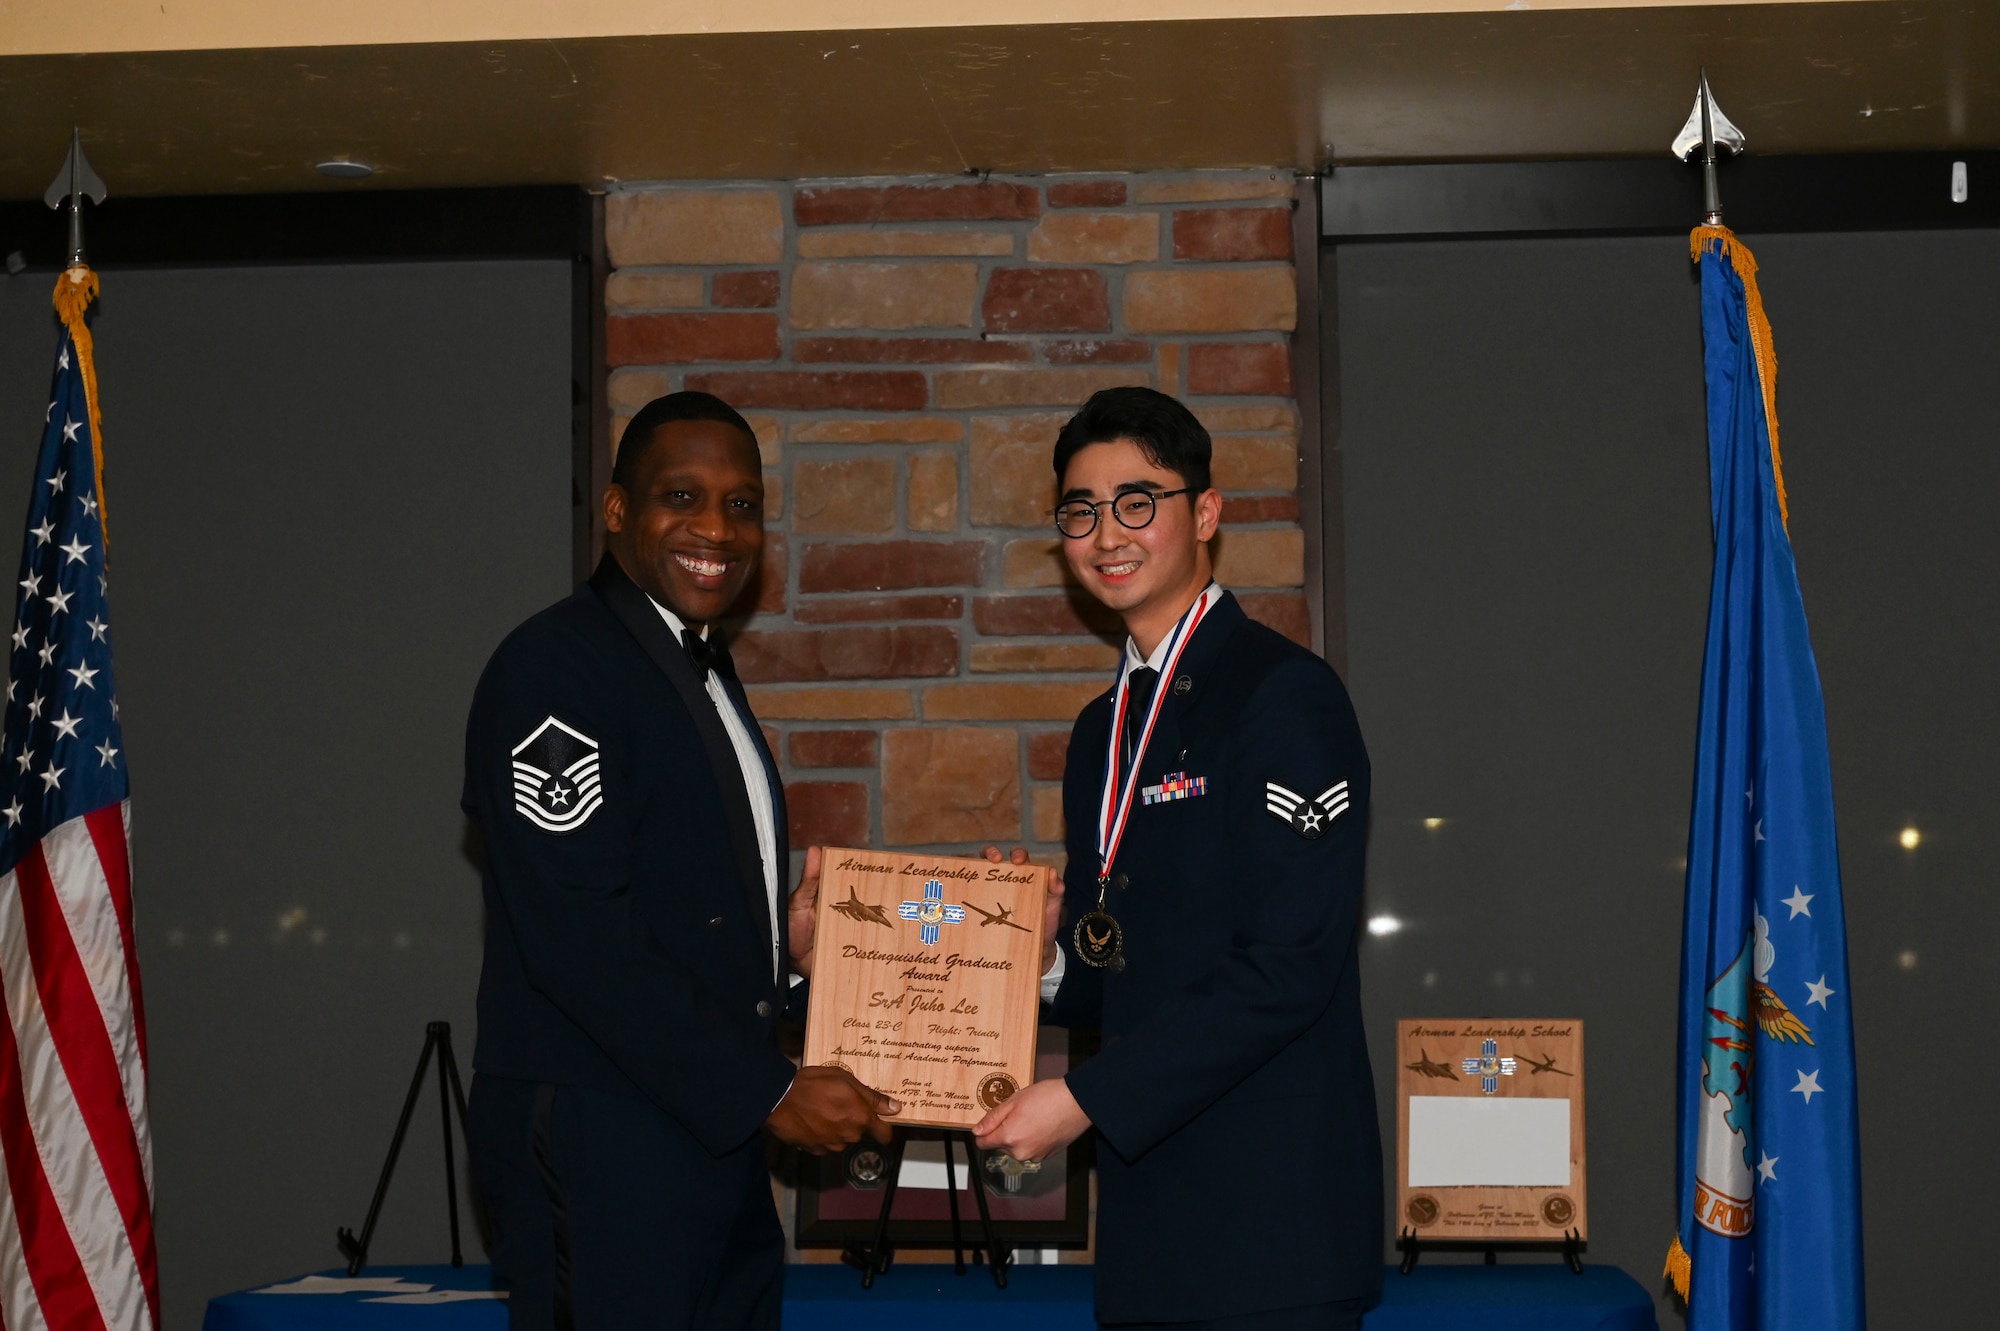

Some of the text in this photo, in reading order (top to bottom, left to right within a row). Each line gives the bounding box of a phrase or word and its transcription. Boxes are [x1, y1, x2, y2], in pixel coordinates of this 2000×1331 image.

[836, 858, 1034, 885] Airman Leadership School
[842, 945, 1013, 971] Distinguished Graduate
[899, 966, 952, 982] Award
[906, 985, 935, 994] Presented
[869, 992, 979, 1015] SrA Juho Lee
[842, 1017, 1000, 1040] Class 23-C Flight: Trinity
[1409, 1025, 1572, 1038] Airman Leadership School
[861, 1035, 980, 1054] For demonstrating superior
[831, 1046, 1008, 1068] Leadership and Academic Performance
[902, 1078, 922, 1087] Given
[944, 1091, 970, 1100] Mexico
[910, 1100, 918, 1108] of
[919, 1100, 951, 1110] February
[953, 1102, 975, 1111] 2023
